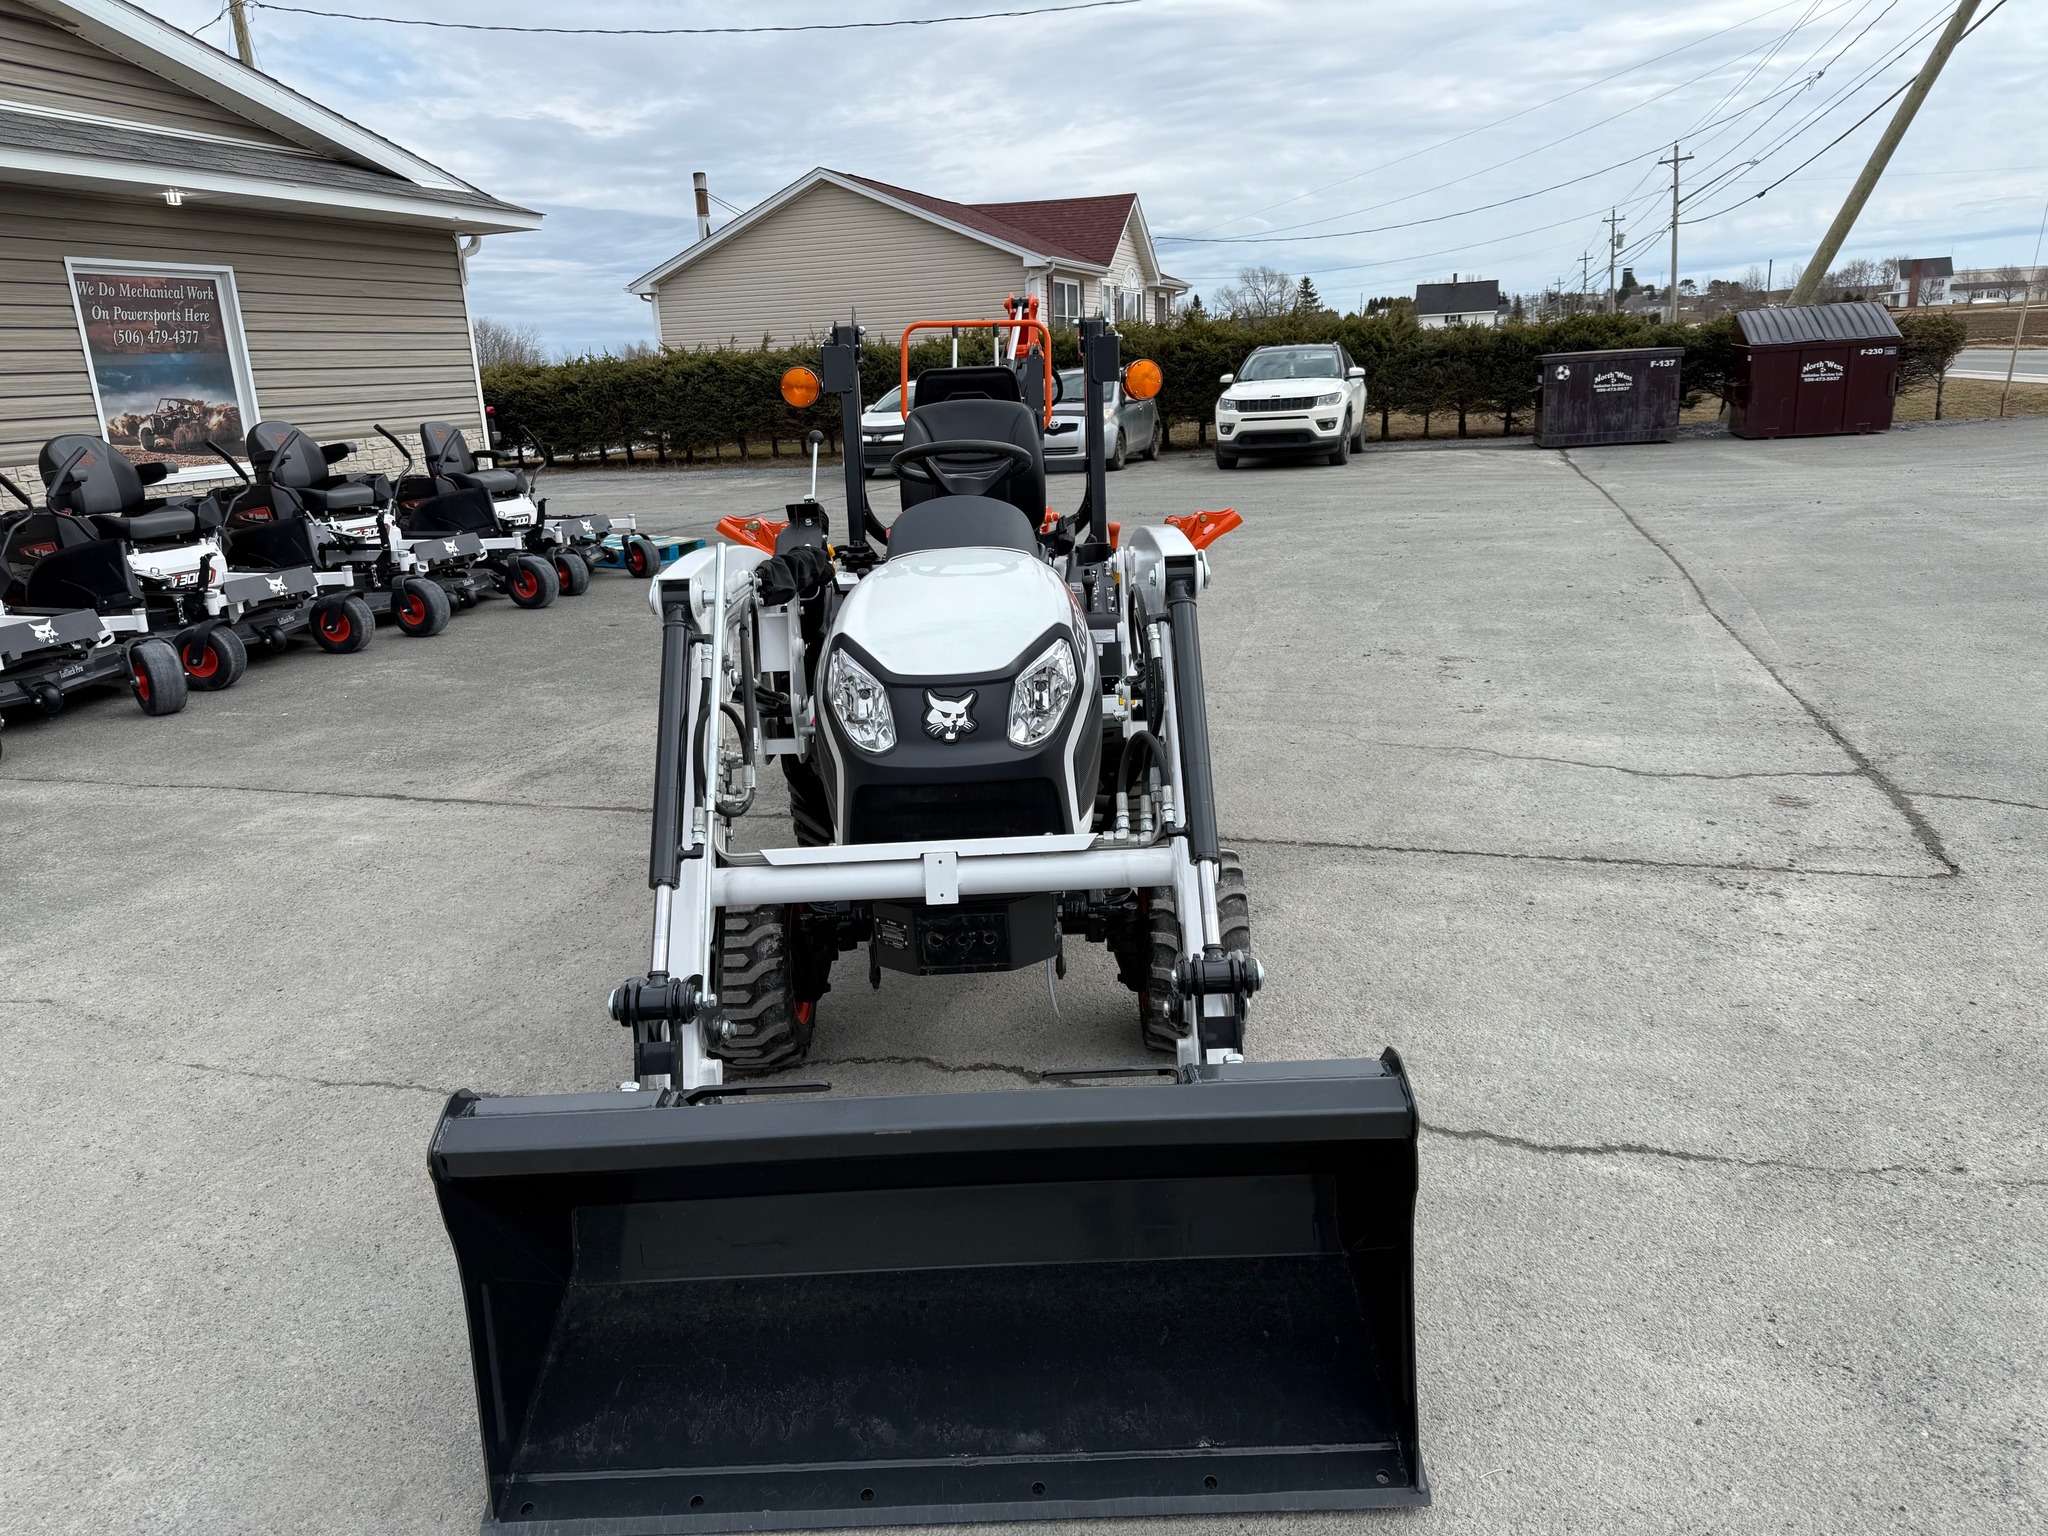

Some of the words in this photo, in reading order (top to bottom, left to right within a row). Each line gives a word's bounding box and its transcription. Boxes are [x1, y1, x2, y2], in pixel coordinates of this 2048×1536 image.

[76, 281, 95, 296] We
[98, 282, 115, 297] Do
[119, 283, 185, 299] Mechanical
[186, 286, 215, 300] Work
[91, 306, 110, 320] On
[113, 306, 182, 325] Powersports
[184, 308, 210, 322] Here
[113, 330, 144, 346] (506)
[147, 330, 199, 344] 479-4377
[1860, 348, 1883, 356] F-230
[1650, 360, 1676, 368] F-137
[1803, 361, 1824, 373] North
[1824, 360, 1844, 372] West
[1594, 372, 1614, 384] North
[1614, 371, 1633, 382] West
